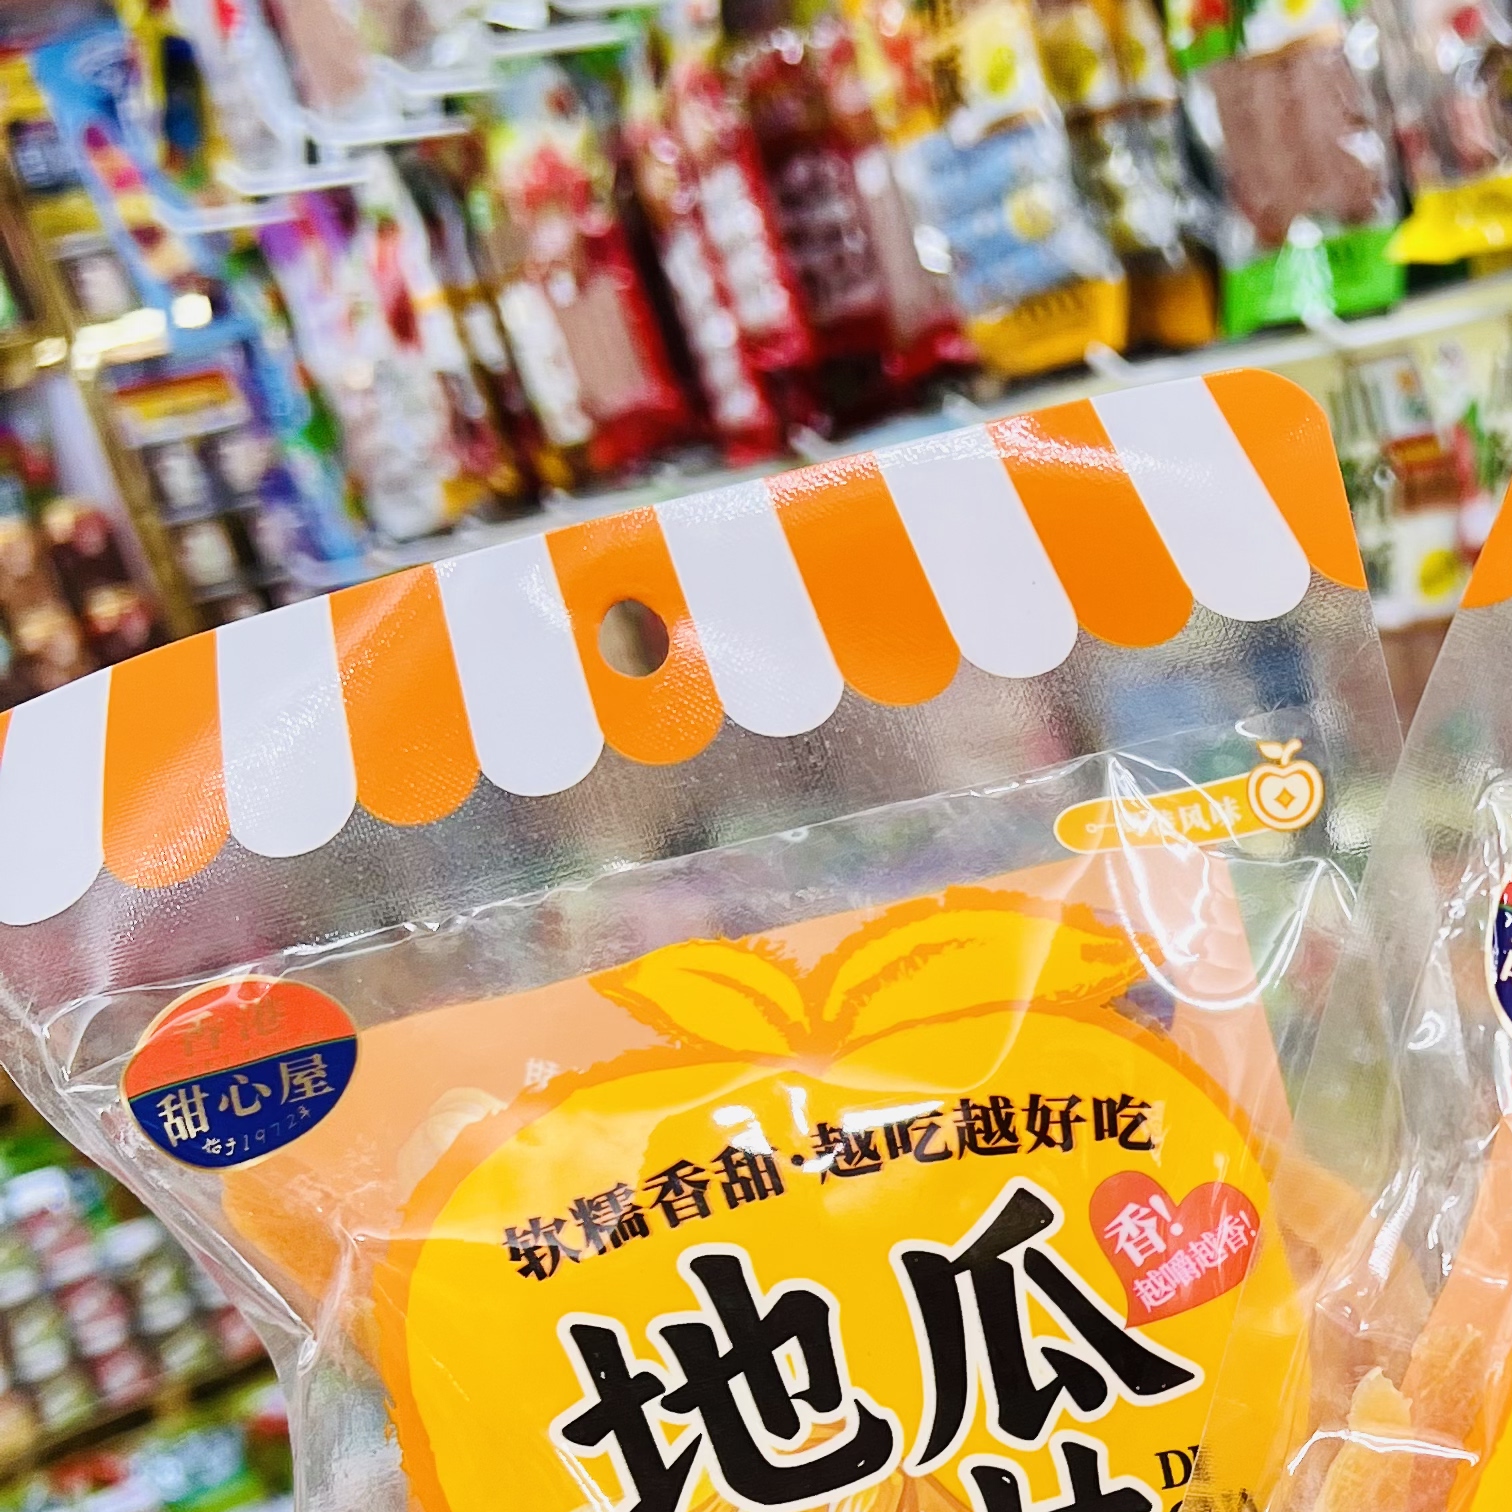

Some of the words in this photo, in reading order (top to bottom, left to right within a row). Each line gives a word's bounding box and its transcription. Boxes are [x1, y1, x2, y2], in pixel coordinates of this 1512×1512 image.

[155, 1052, 336, 1149] 甜心屋
[1132, 1208, 1258, 1313] 越嚼越香!
